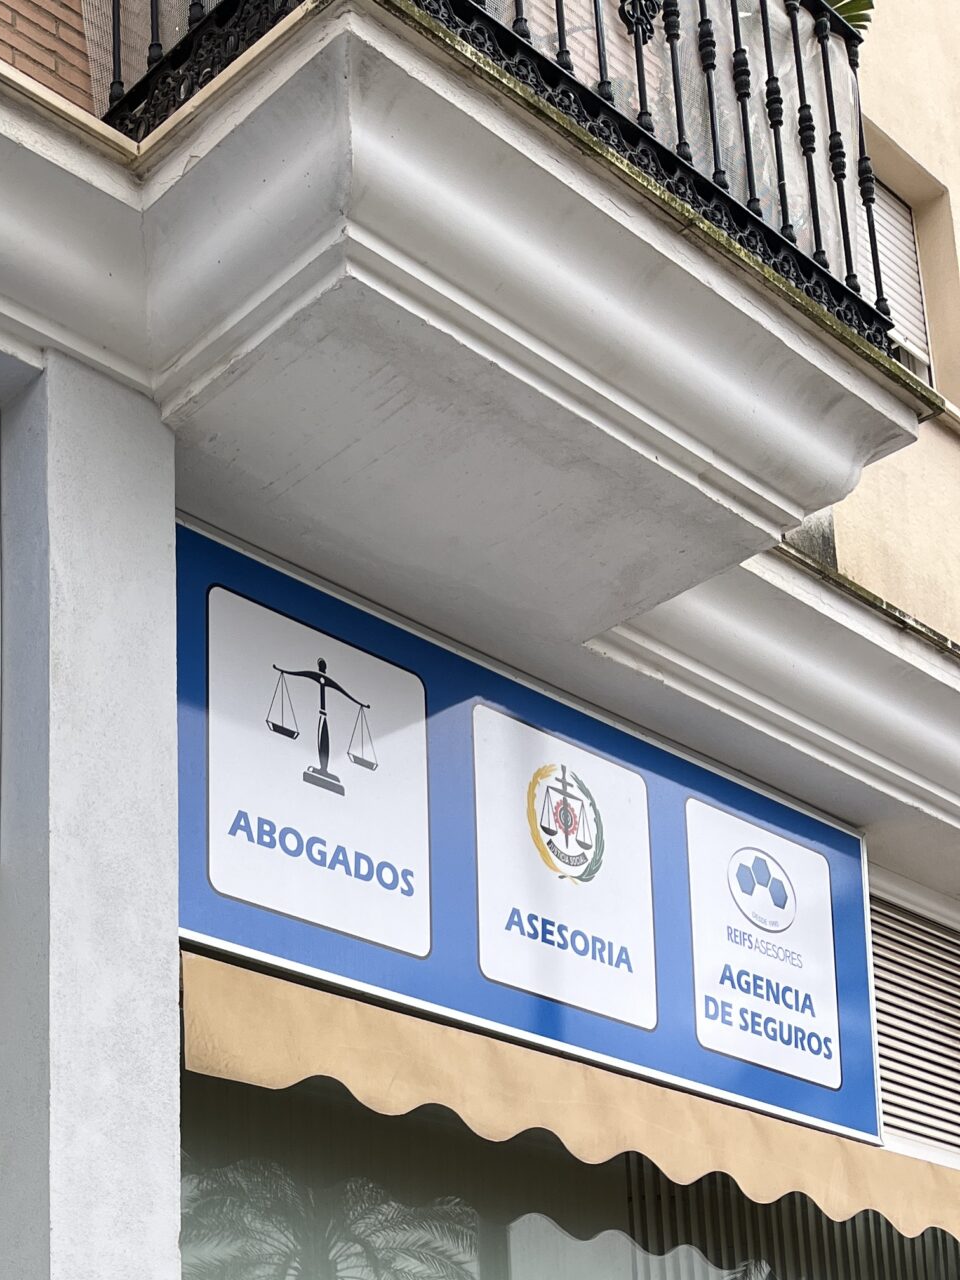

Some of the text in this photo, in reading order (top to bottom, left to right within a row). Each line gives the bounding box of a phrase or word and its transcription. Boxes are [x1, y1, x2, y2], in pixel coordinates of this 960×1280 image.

[228, 809, 414, 897] ABOGADOS
[548, 842, 569, 864] JUSTICIA
[505, 907, 633, 973] ASESORIA
[726, 925, 803, 969] REIFS ASESORES
[719, 963, 816, 1018] AGENCIA
[704, 994, 833, 1060] DE SEGUROS
